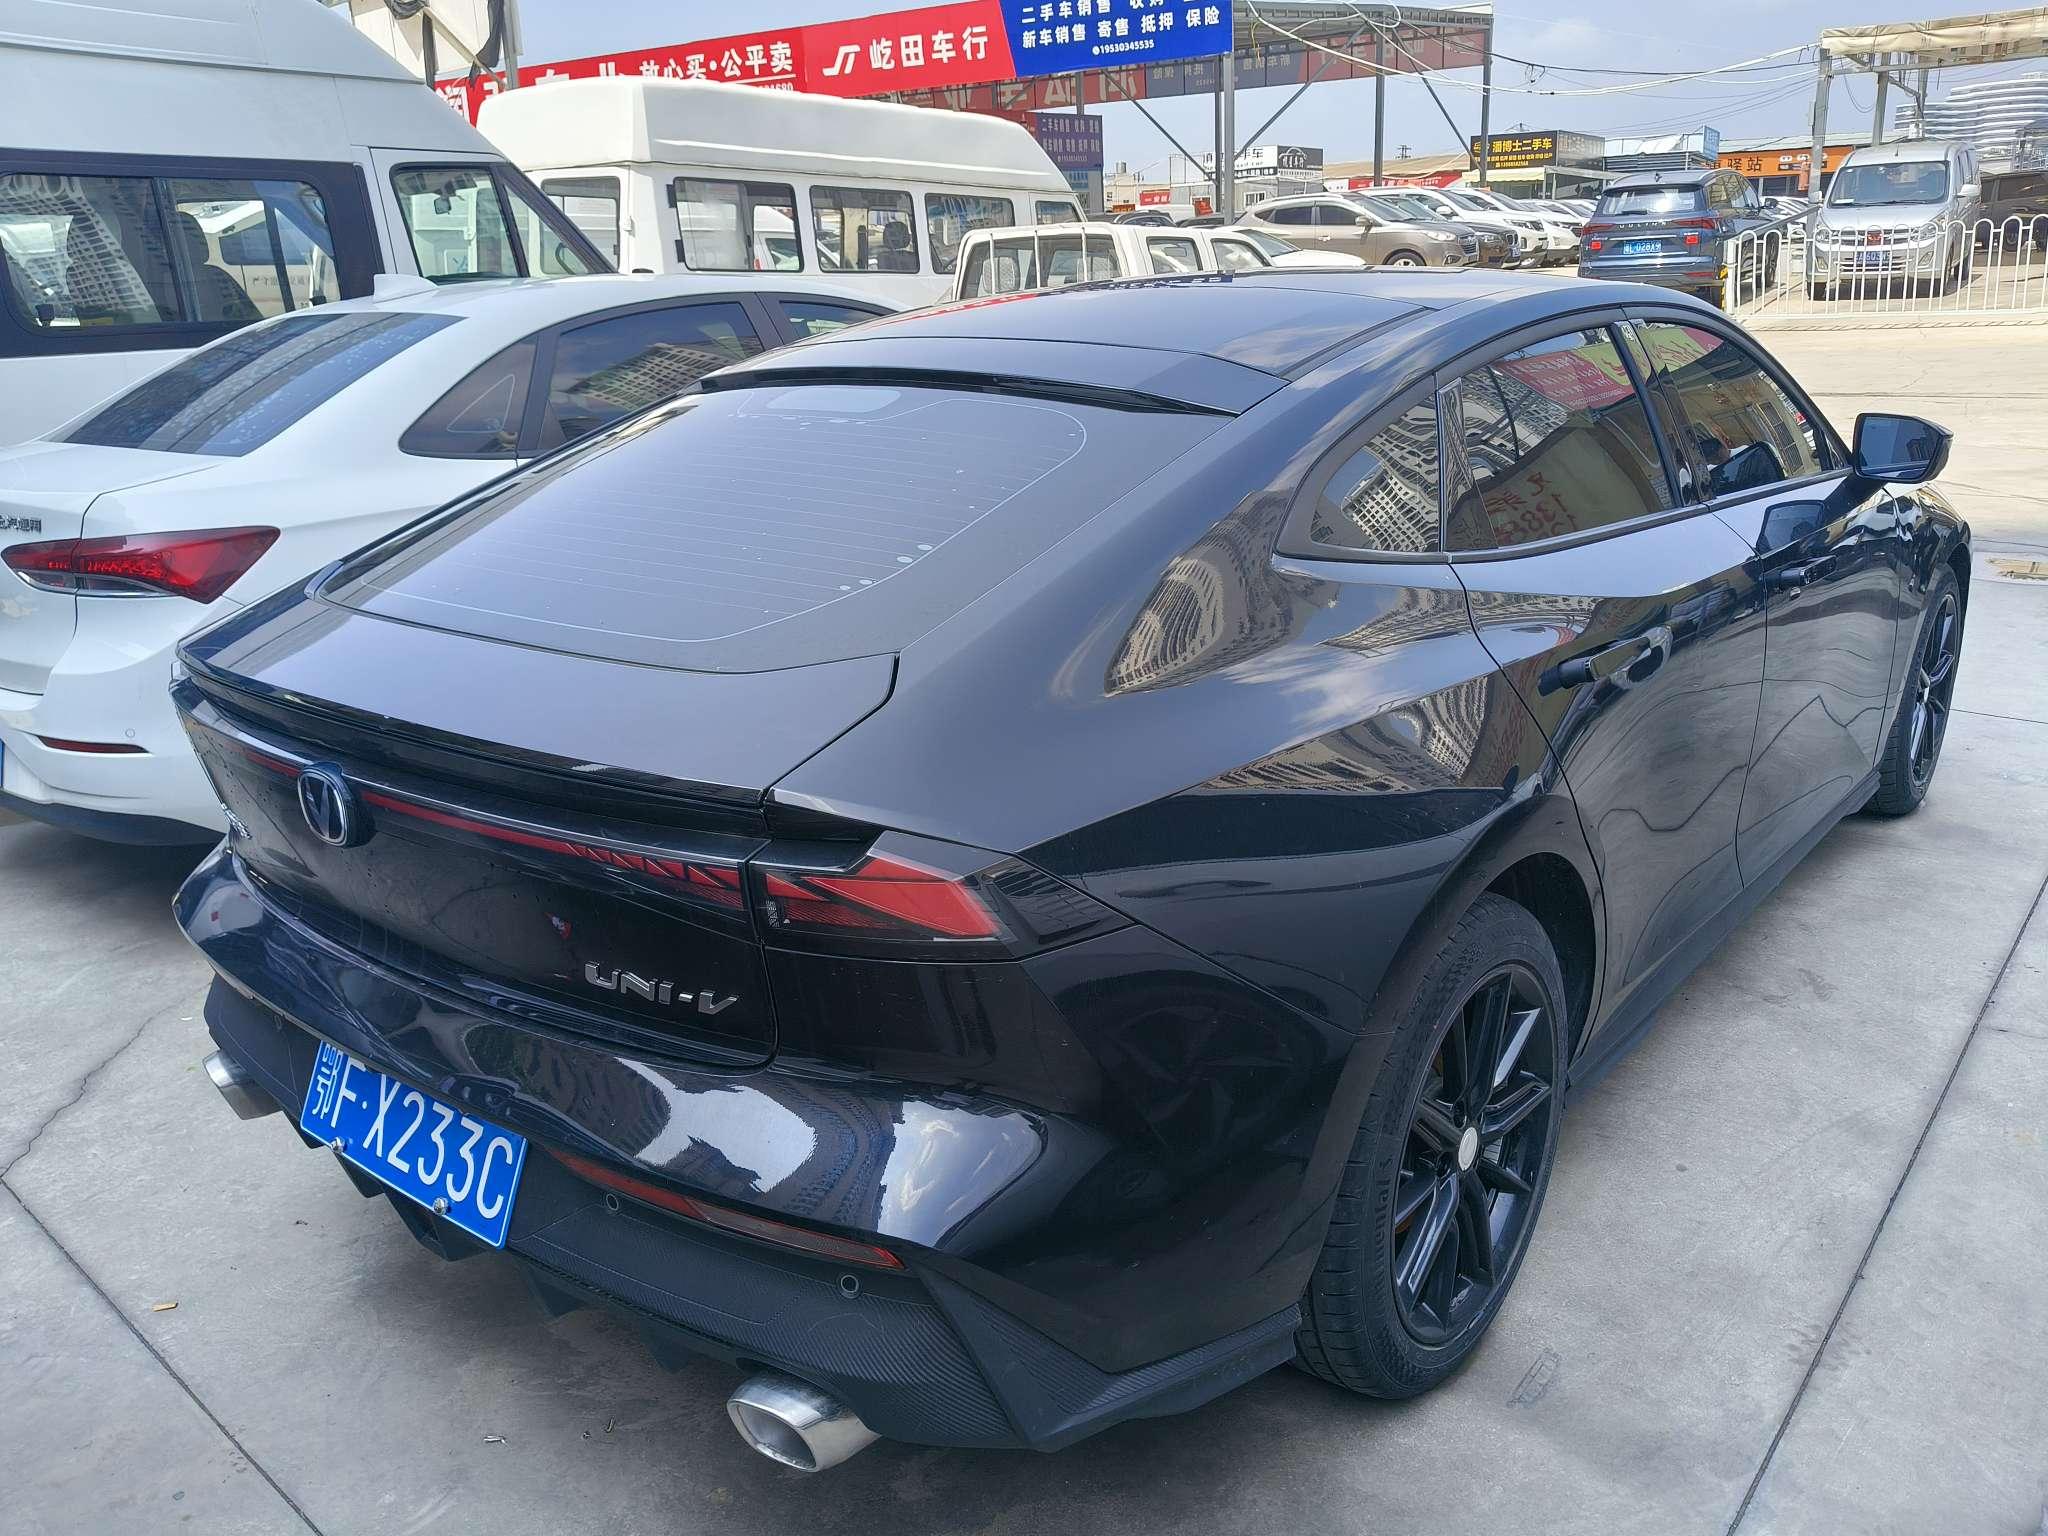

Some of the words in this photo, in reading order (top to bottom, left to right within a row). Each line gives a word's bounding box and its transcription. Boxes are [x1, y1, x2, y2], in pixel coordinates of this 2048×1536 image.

[1022, 0, 1110, 24] 二手车销售
[1022, 23, 1086, 48] 新车销售
[1097, 17, 1129, 39] 寄售
[1141, 12, 1173, 34] 抵押
[1186, 6, 1220, 27] 保险
[869, 25, 989, 70] 屹田车行
[1100, 39, 1155, 55] 19530345535
[584, 960, 740, 1015] UNI-V
